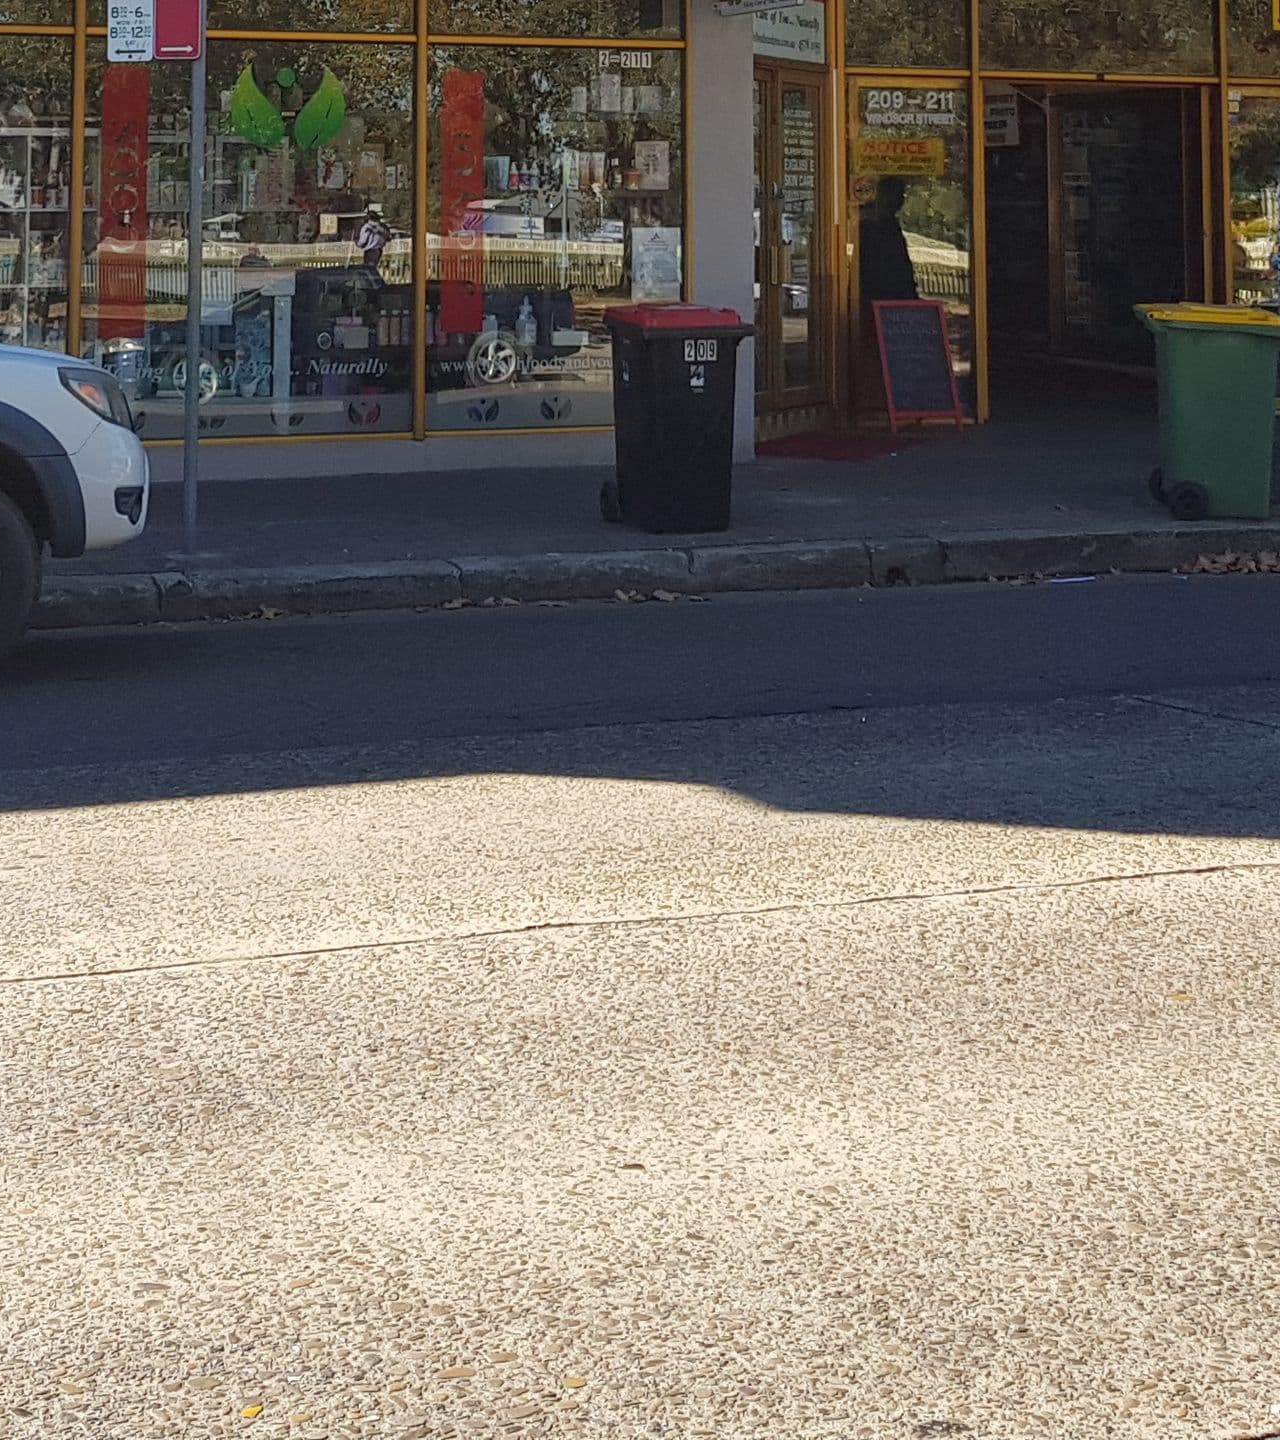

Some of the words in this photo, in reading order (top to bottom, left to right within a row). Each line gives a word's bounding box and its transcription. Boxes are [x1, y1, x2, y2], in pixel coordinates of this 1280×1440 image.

[867, 90, 904, 109] 209
[925, 91, 954, 110] 211
[865, 111, 915, 127] WINDSOR
[915, 112, 957, 127] STREET
[861, 140, 929, 155] NOTICE
[685, 340, 717, 361] 209
[306, 359, 389, 378] Naturally
